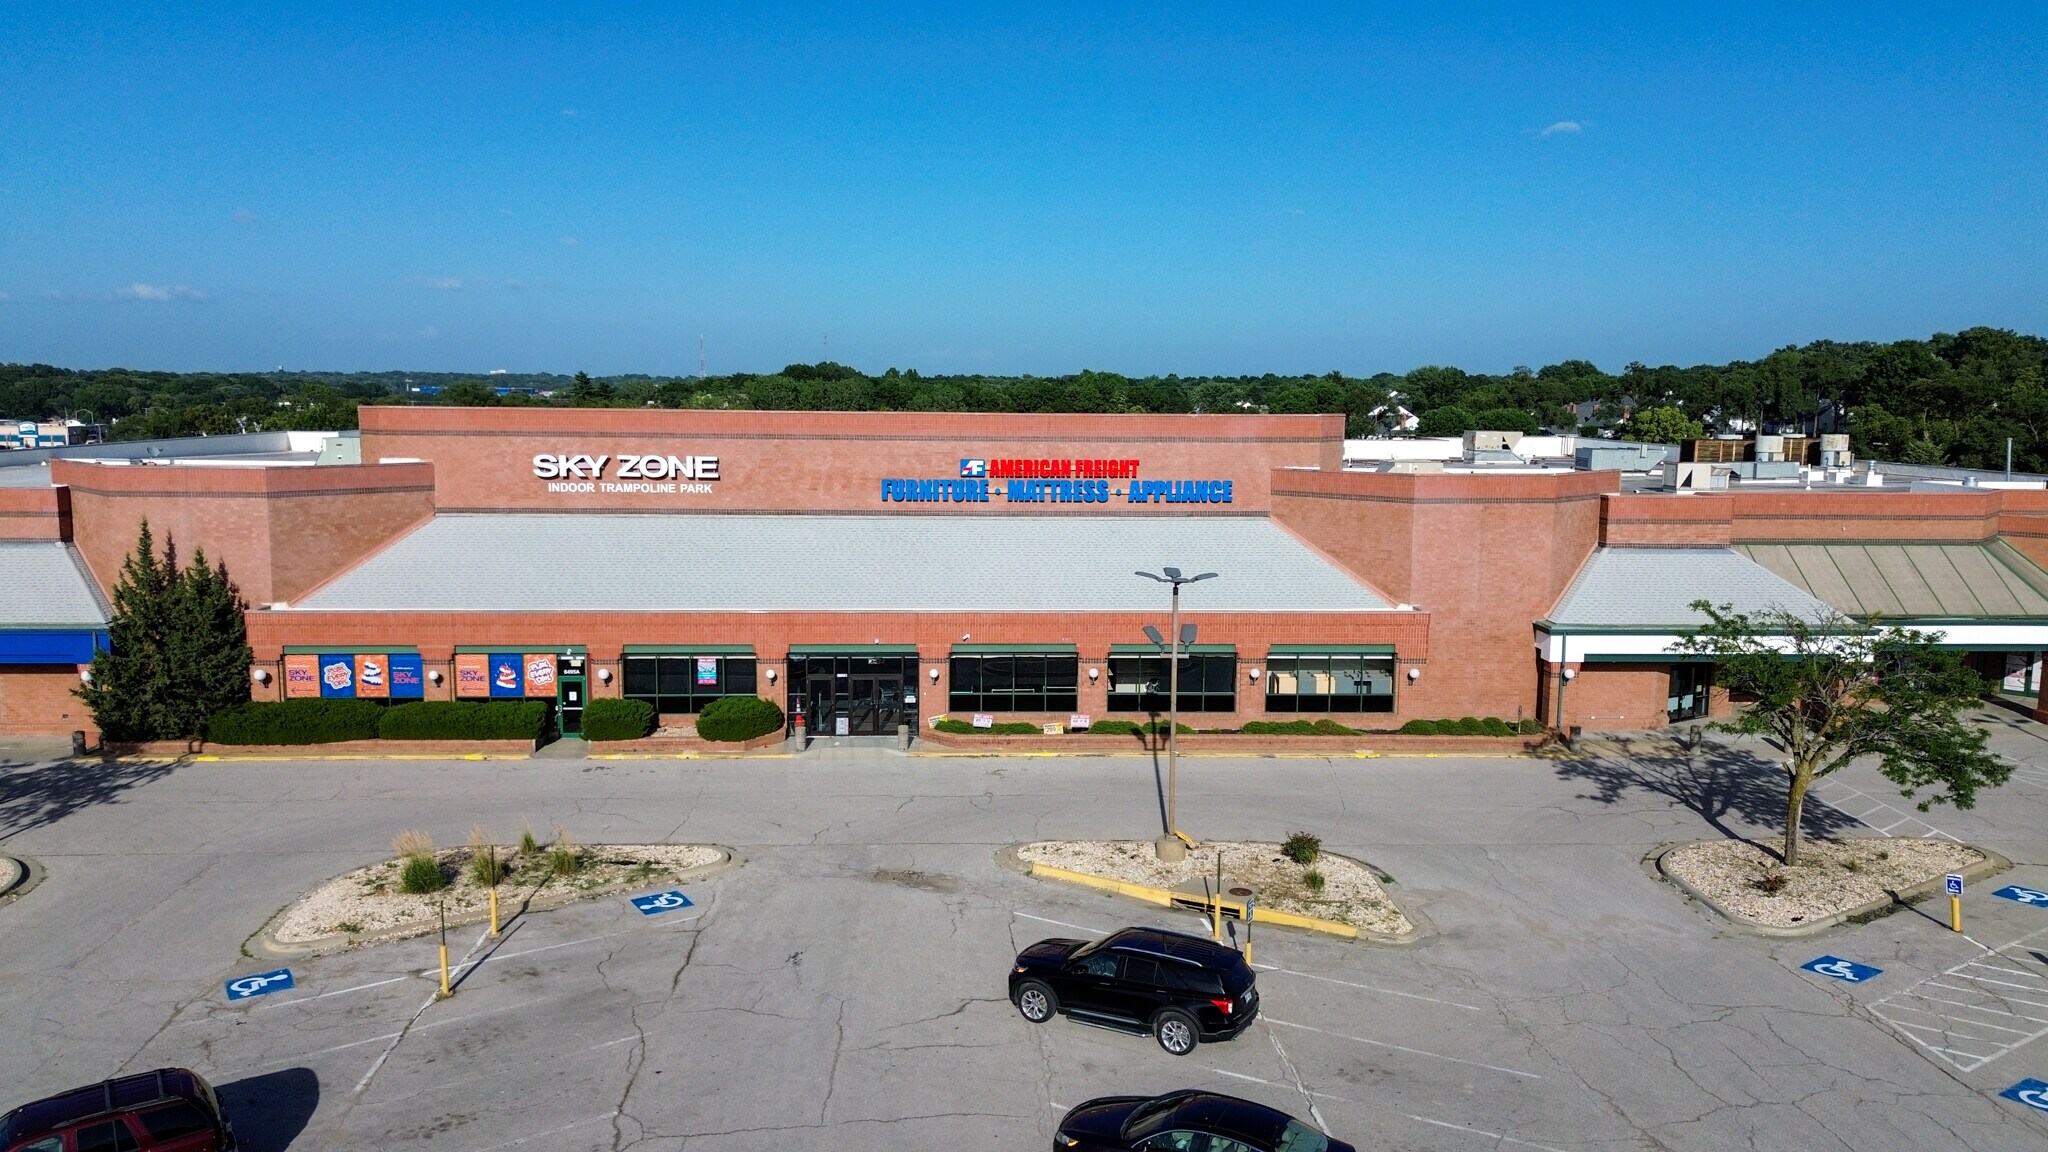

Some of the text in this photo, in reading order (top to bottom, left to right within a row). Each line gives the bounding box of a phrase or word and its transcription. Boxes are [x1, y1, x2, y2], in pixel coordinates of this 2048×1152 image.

[533, 454, 720, 480] SKY ZONE
[989, 460, 1139, 478] AMERICAN FREIGHT
[548, 483, 712, 494] INDOOR TRAMPOLINE PARK
[881, 479, 1233, 503] FURNITURE MATTRESS APPLIANCE
[529, 667, 552, 678] EVERY
